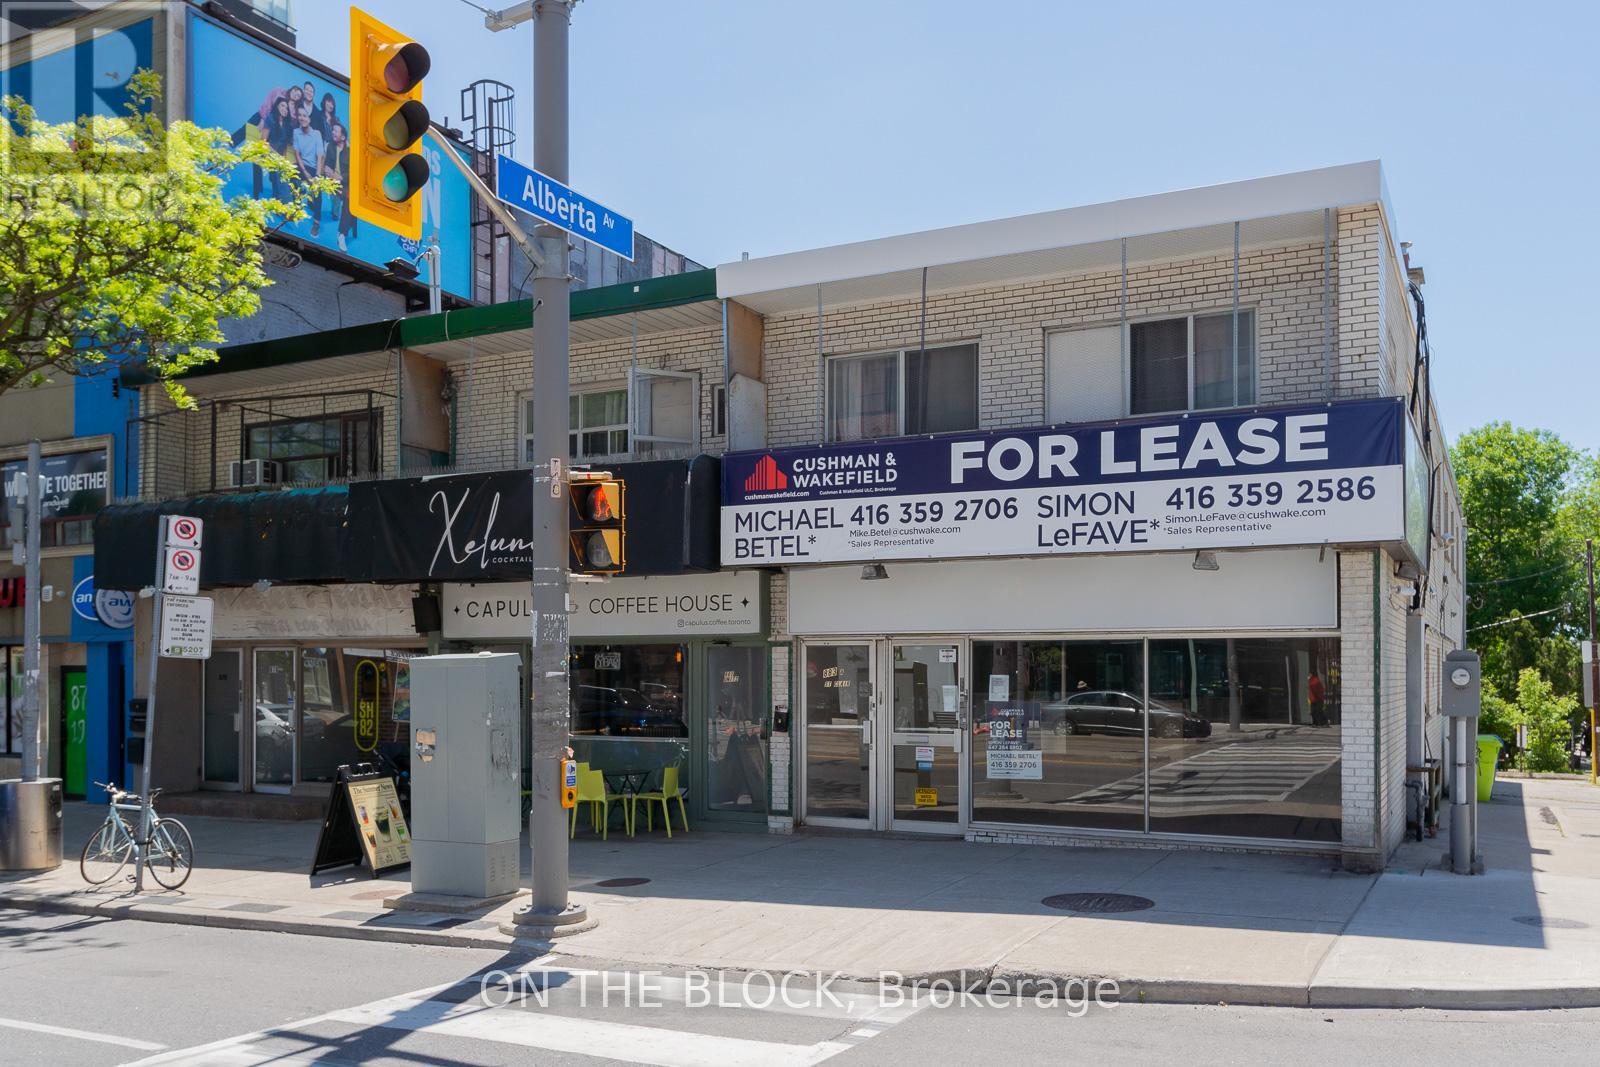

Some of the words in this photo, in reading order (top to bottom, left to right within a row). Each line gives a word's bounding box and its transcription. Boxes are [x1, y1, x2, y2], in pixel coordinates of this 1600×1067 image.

[522, 175, 597, 234] Alberta
[602, 213, 615, 230] Av
[951, 435, 1079, 484] FOR
[1101, 413, 1329, 475] LEASE
[793, 453, 880, 472] CUSHMAN
[885, 452, 897, 466] &
[793, 469, 898, 488] WAKEFIELD
[744, 490, 810, 501] cushmanwakefield.com
[1166, 485, 1215, 511] 416
[1227, 482, 1283, 507] 359
[1296, 476, 1376, 504] 2586
[1037, 490, 1135, 519] SIMON
[735, 506, 844, 534] MICHAEL
[850, 503, 890, 526] 416
[900, 501, 943, 524] 359
[954, 497, 1018, 522] 2706
[1165, 507, 1326, 524] Simon.LeFave@cushwake.com
[429, 487, 533, 577] Xelun
[849, 526, 961, 538] Mike.Betel@cushwake.com
[1195, 522, 1272, 534] Representative
[873, 538, 935, 547] Representative
[466, 599, 532, 619] CAPUL
[589, 596, 658, 614] COFFEE
[665, 594, 733, 613] HOUSE
[990, 721, 1011, 729] FOR
[990, 729, 1023, 738] LEASE
